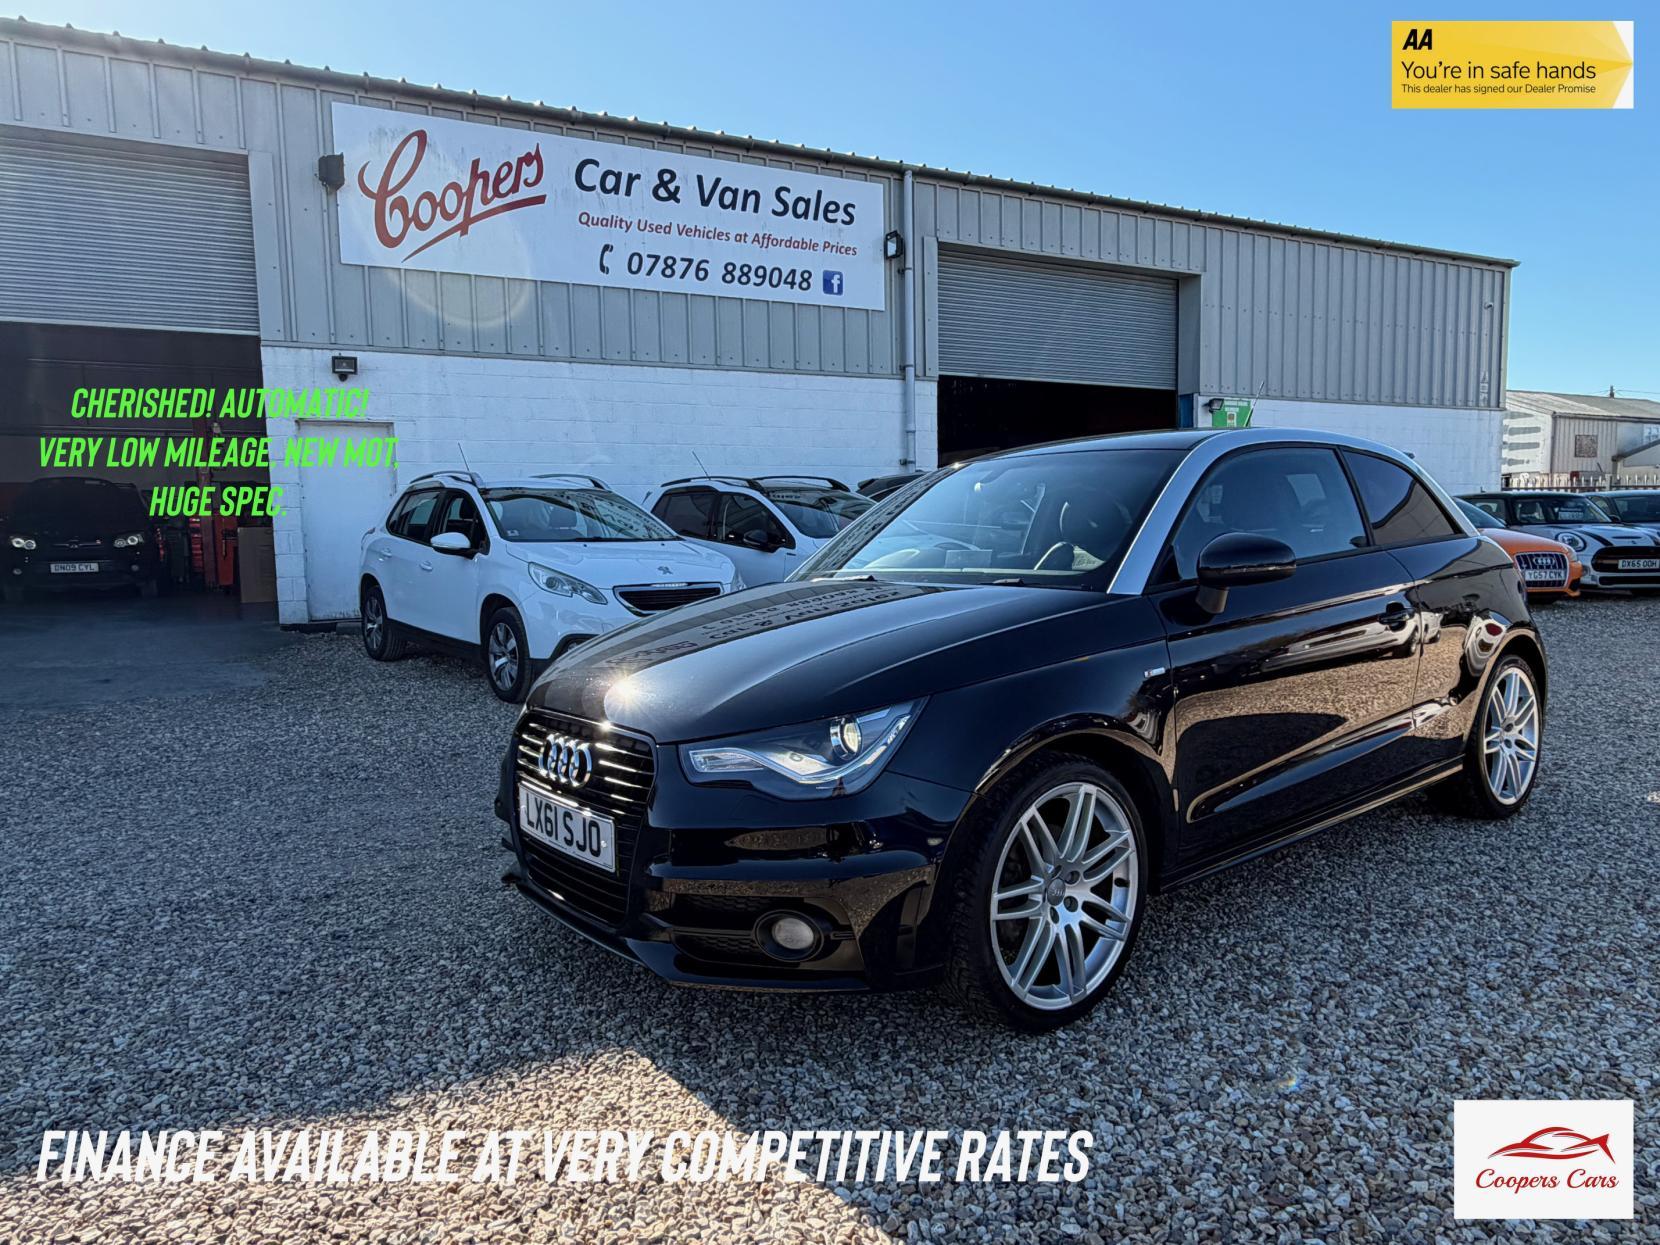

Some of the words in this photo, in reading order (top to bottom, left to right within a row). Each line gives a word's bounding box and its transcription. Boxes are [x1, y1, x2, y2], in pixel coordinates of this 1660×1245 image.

[358, 129, 548, 264] Coopers
[575, 158, 641, 197] Car
[651, 168, 681, 204] &
[696, 174, 761, 213] Van
[771, 186, 856, 226] Sales
[578, 211, 633, 233] Quality
[637, 219, 672, 235] Used
[677, 223, 731, 242] Vehicles
[734, 231, 748, 244] at
[751, 233, 819, 252] Affordable
[822, 241, 857, 256] Prices
[626, 252, 709, 281] 07876
[721, 262, 813, 291] 889048
[526, 792, 559, 841] LX61
[563, 810, 601, 858] SJO
